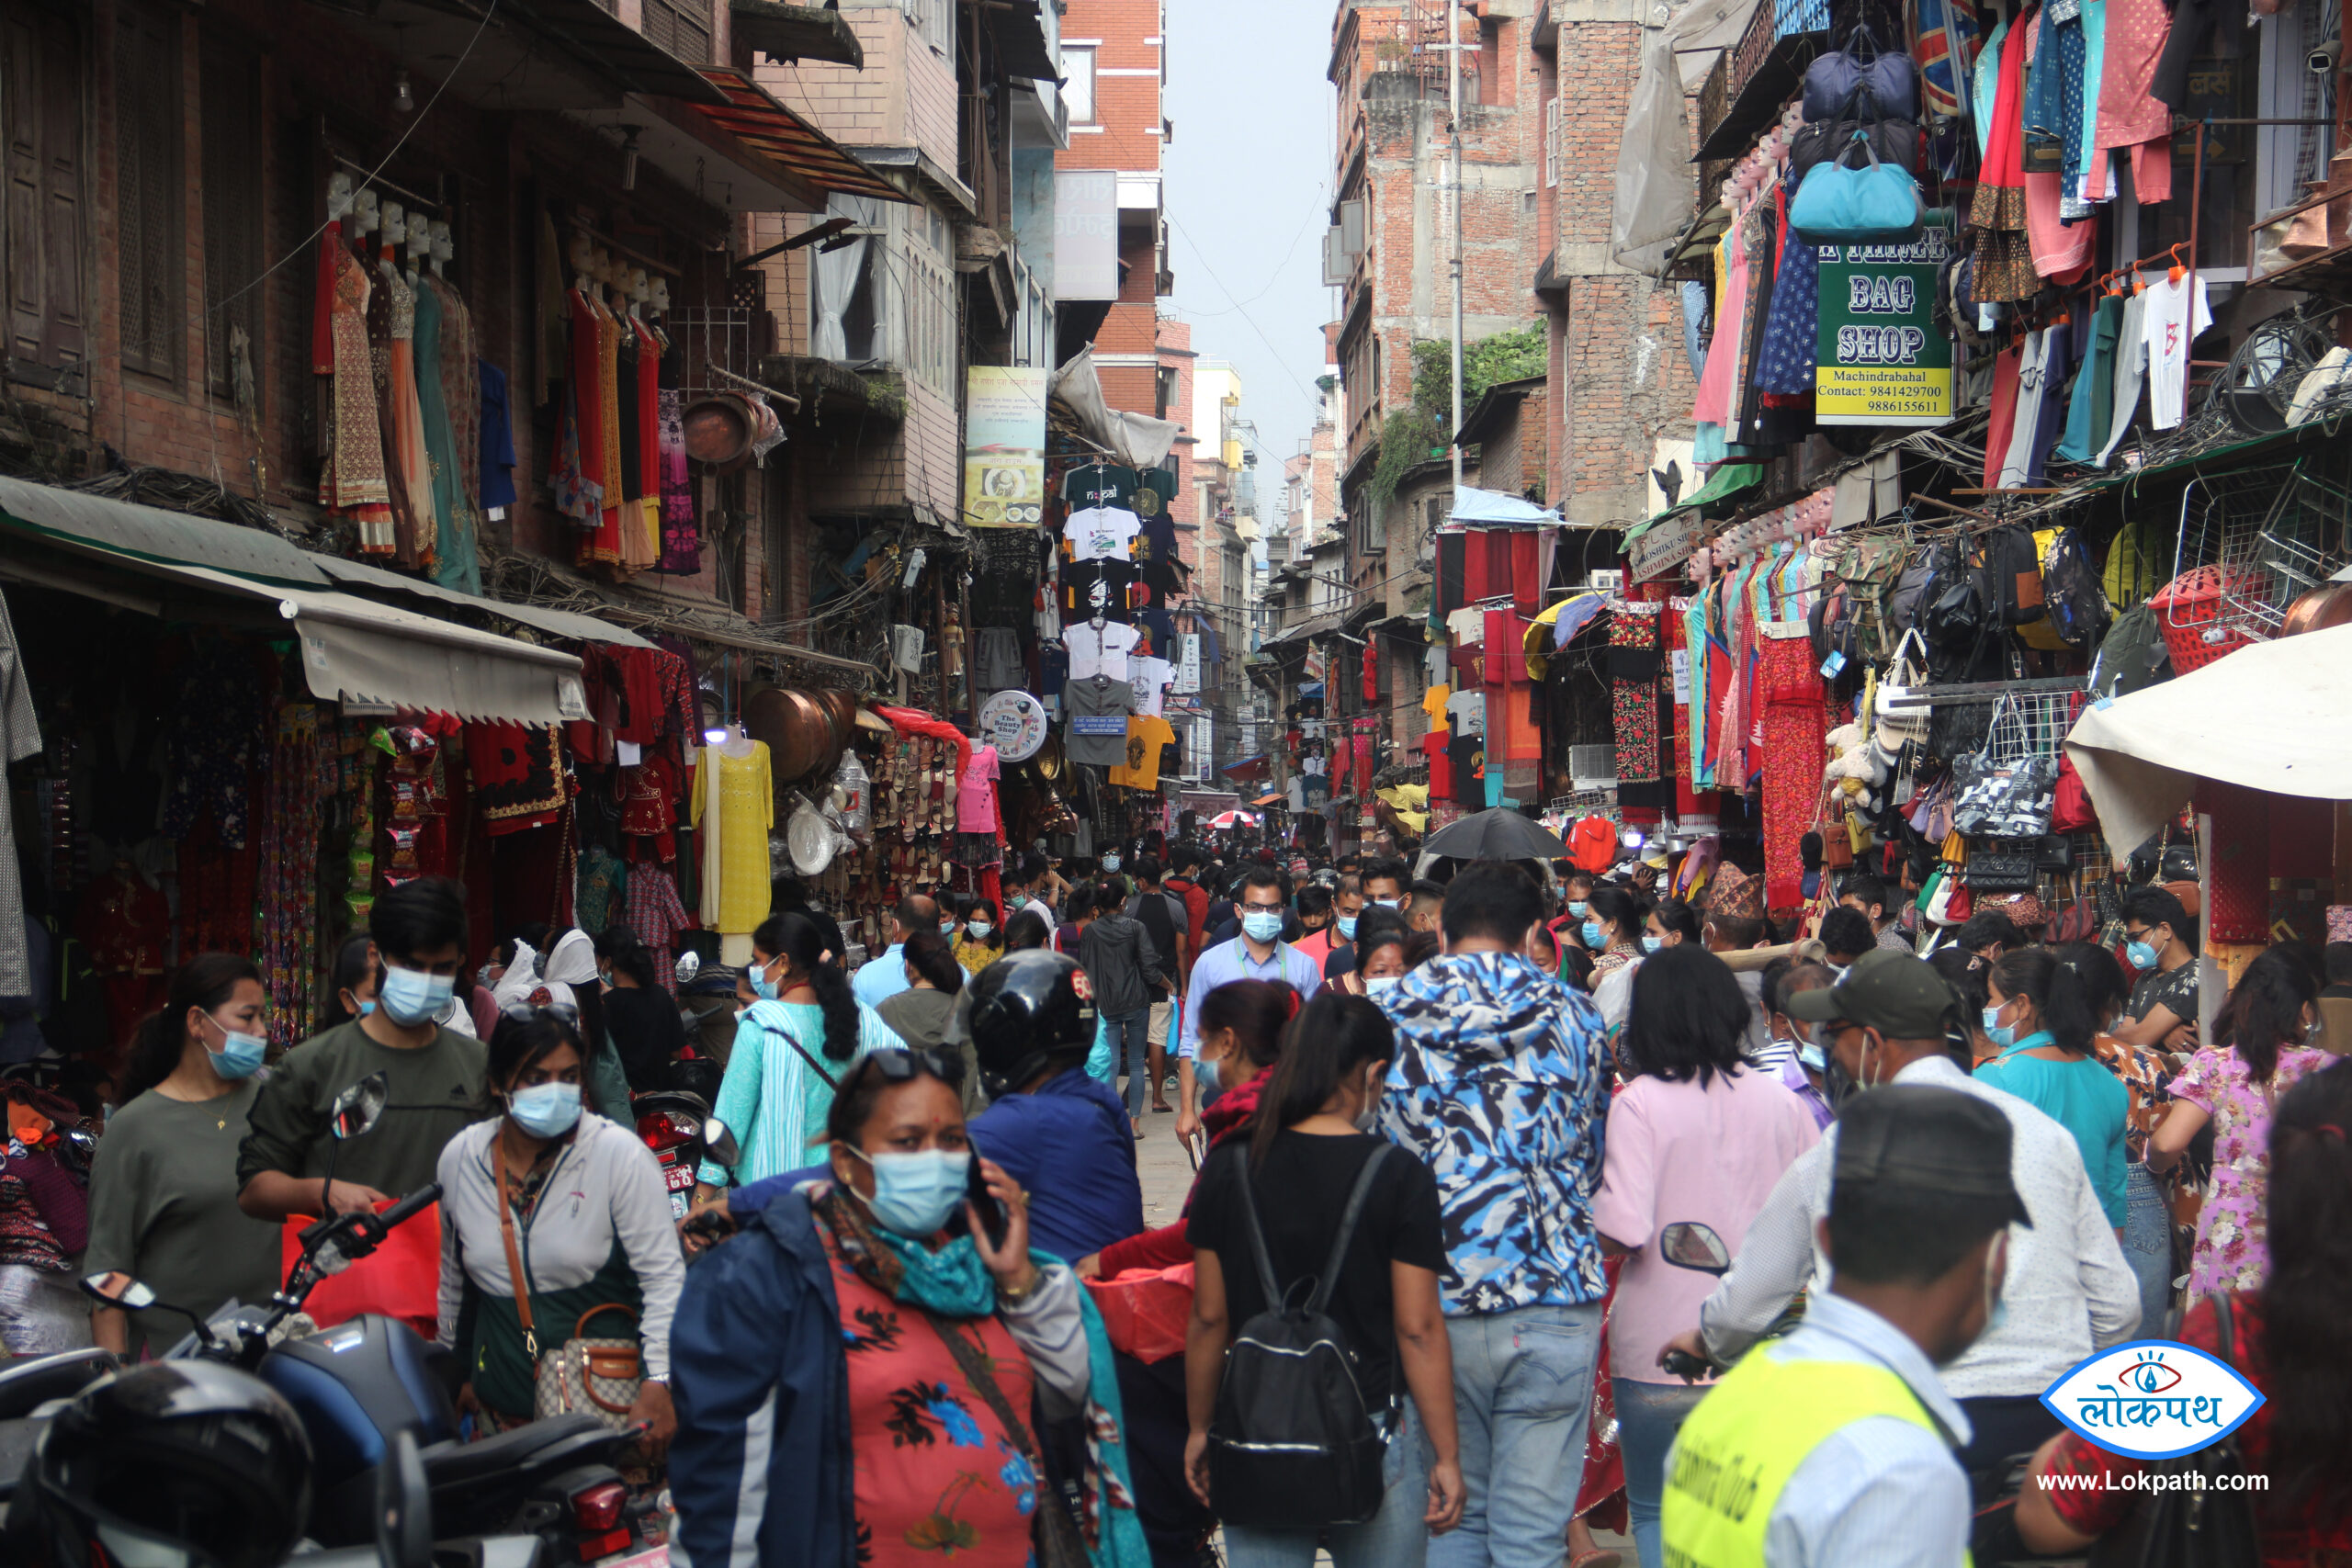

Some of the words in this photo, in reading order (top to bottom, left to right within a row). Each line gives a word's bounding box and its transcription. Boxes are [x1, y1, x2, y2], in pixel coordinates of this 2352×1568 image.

[1849, 275, 1915, 314] BAG
[1838, 325, 1925, 364] SHOP
[1834, 370, 1926, 382] Machindrabahal
[1817, 385, 1866, 397] Contact:
[1870, 386, 1941, 397] 9841429700
[1868, 400, 1938, 412] 9886155611
[994, 720, 1022, 728] Beauty
[998, 726, 1018, 734] Shop
